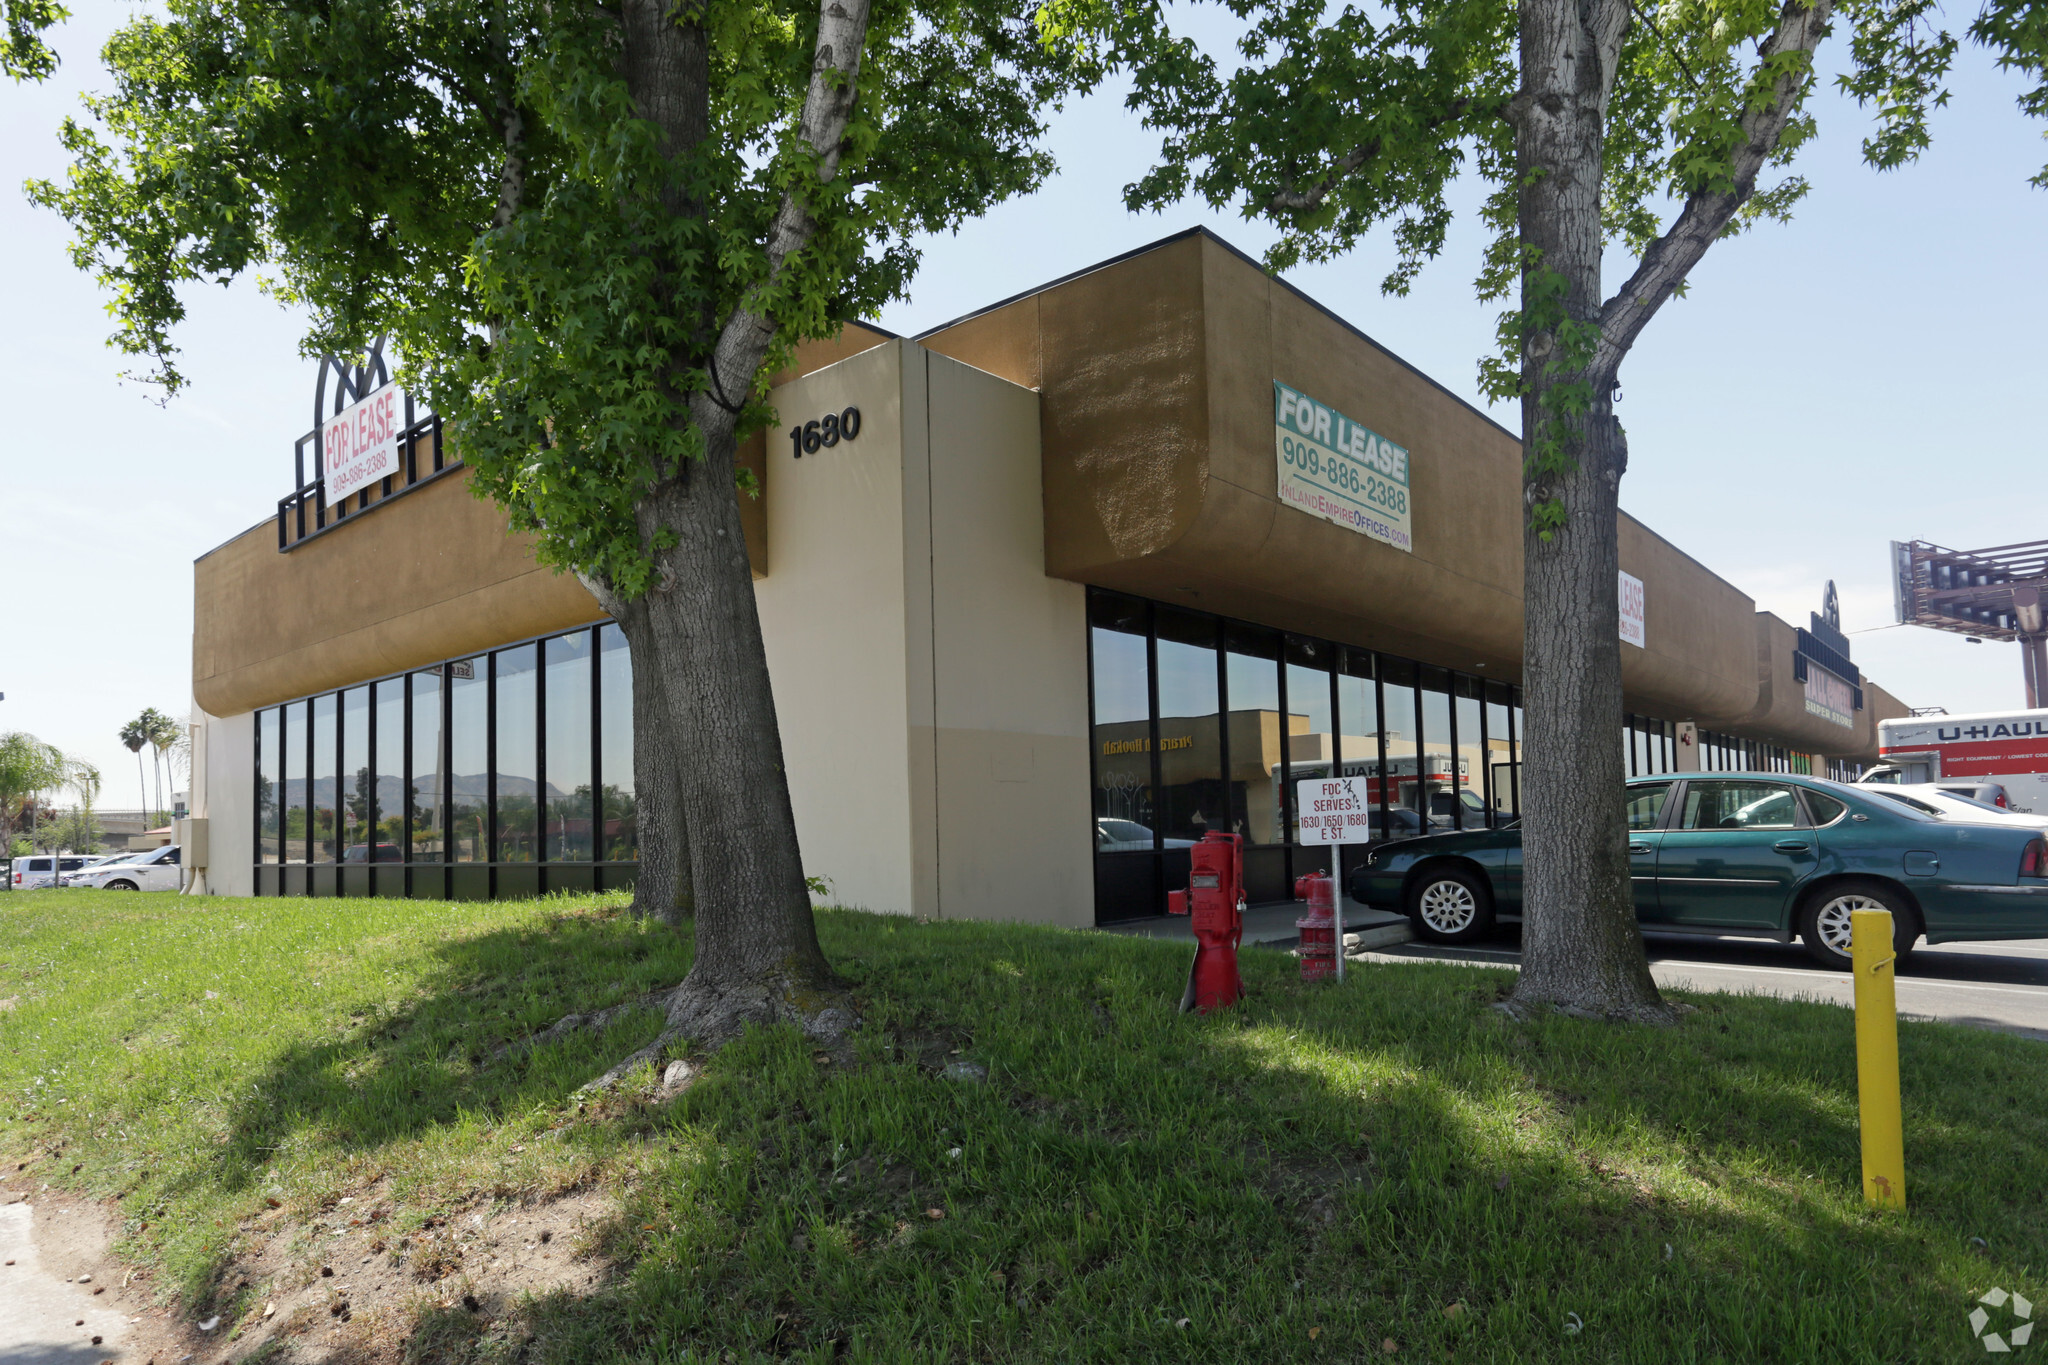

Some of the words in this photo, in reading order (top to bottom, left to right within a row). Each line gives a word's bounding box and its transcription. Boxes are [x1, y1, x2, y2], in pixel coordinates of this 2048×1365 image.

[326, 421, 349, 474] FOR
[352, 391, 395, 458] LEASE
[789, 405, 861, 459] 1680
[1278, 387, 1331, 446] FOR
[1336, 417, 1407, 483] LEASE
[332, 450, 388, 495] 909-886-2388
[1282, 436, 1407, 515] 909-886-2388
[1280, 480, 1410, 547] INLANDEMPIREOFFICES.COM
[1620, 577, 1643, 622] LEASE
[1805, 699, 1831, 719] SUPER
[1831, 711, 1853, 728] STORE
[1937, 721, 2048, 741] U-HAUL
[1313, 798, 1352, 812] SERVES
[1322, 783, 1341, 795] FDC
[1300, 813, 1367, 828] 1630/1650/1680
[1321, 828, 1328, 840] E
[1331, 827, 1346, 840] ST.
